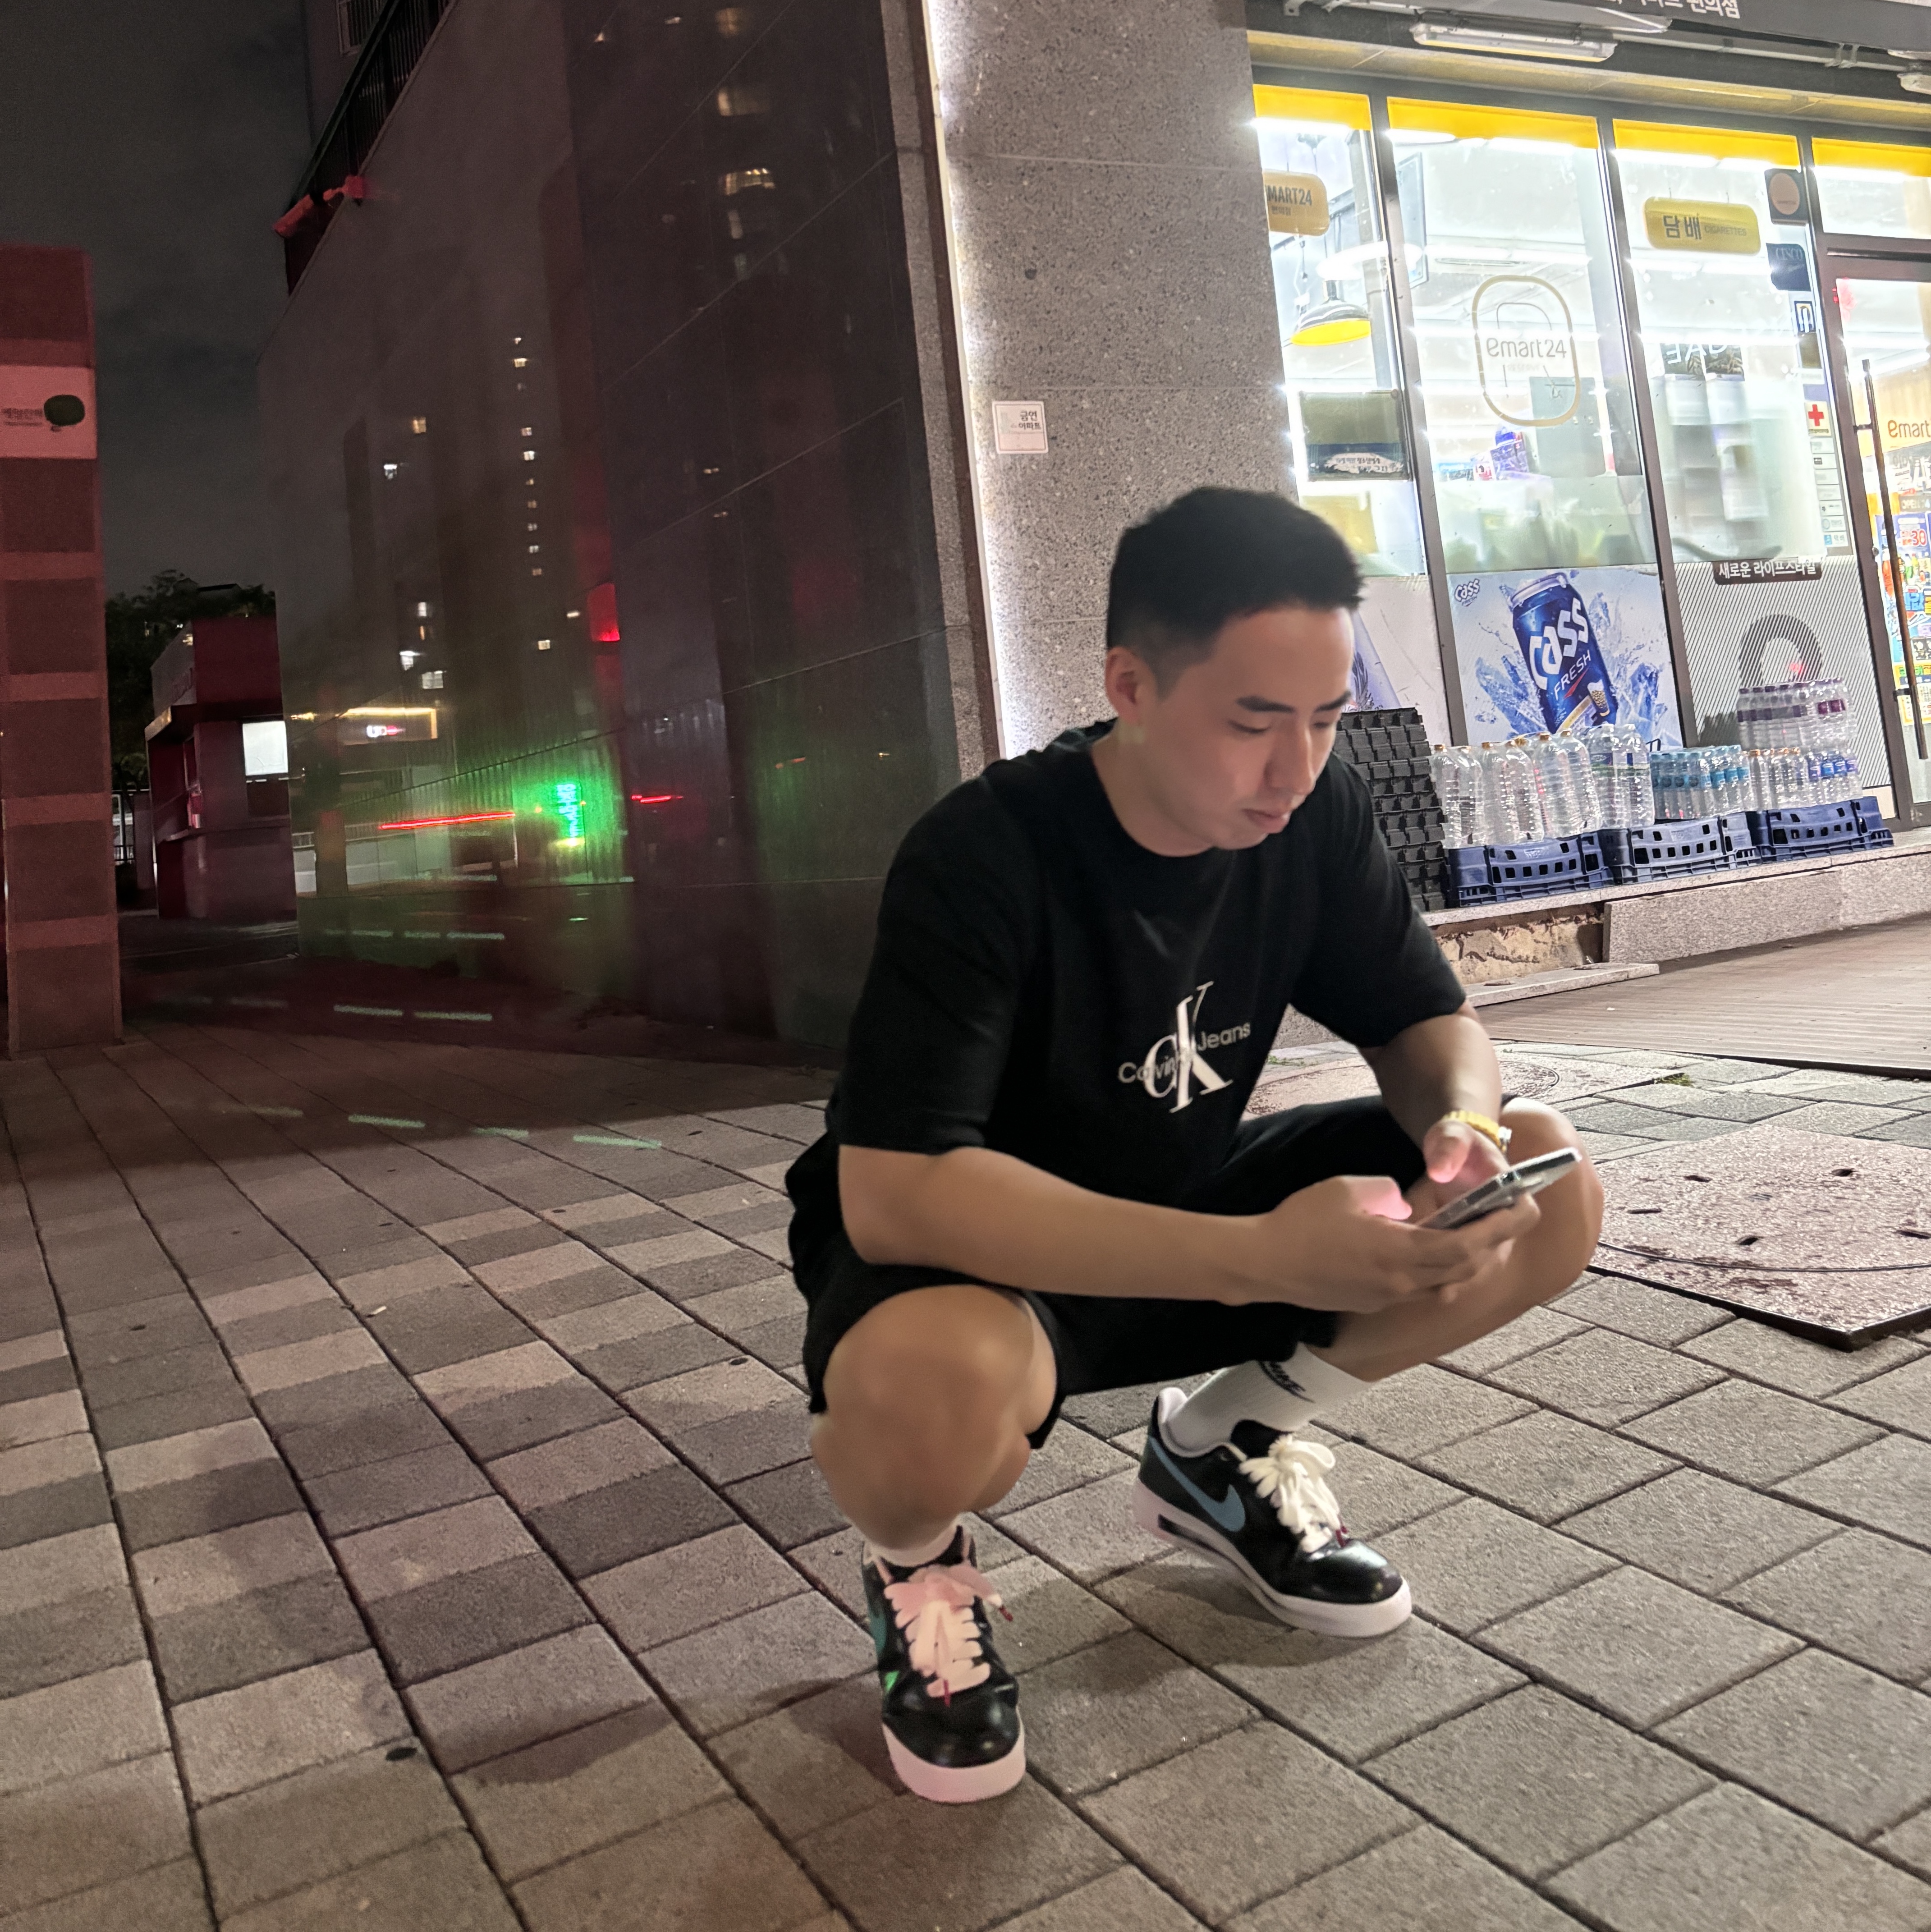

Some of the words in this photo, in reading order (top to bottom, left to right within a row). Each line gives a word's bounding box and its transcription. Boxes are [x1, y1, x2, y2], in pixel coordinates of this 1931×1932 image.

[1486, 337, 1567, 358] emart24
[1020, 410, 1037, 422] 금연
[1719, 562, 1751, 579] 새로운
[1753, 559, 1816, 577] 라이프스타일
[1554, 649, 1591, 701] FRESH
[1197, 1022, 1251, 1051] Jeans
